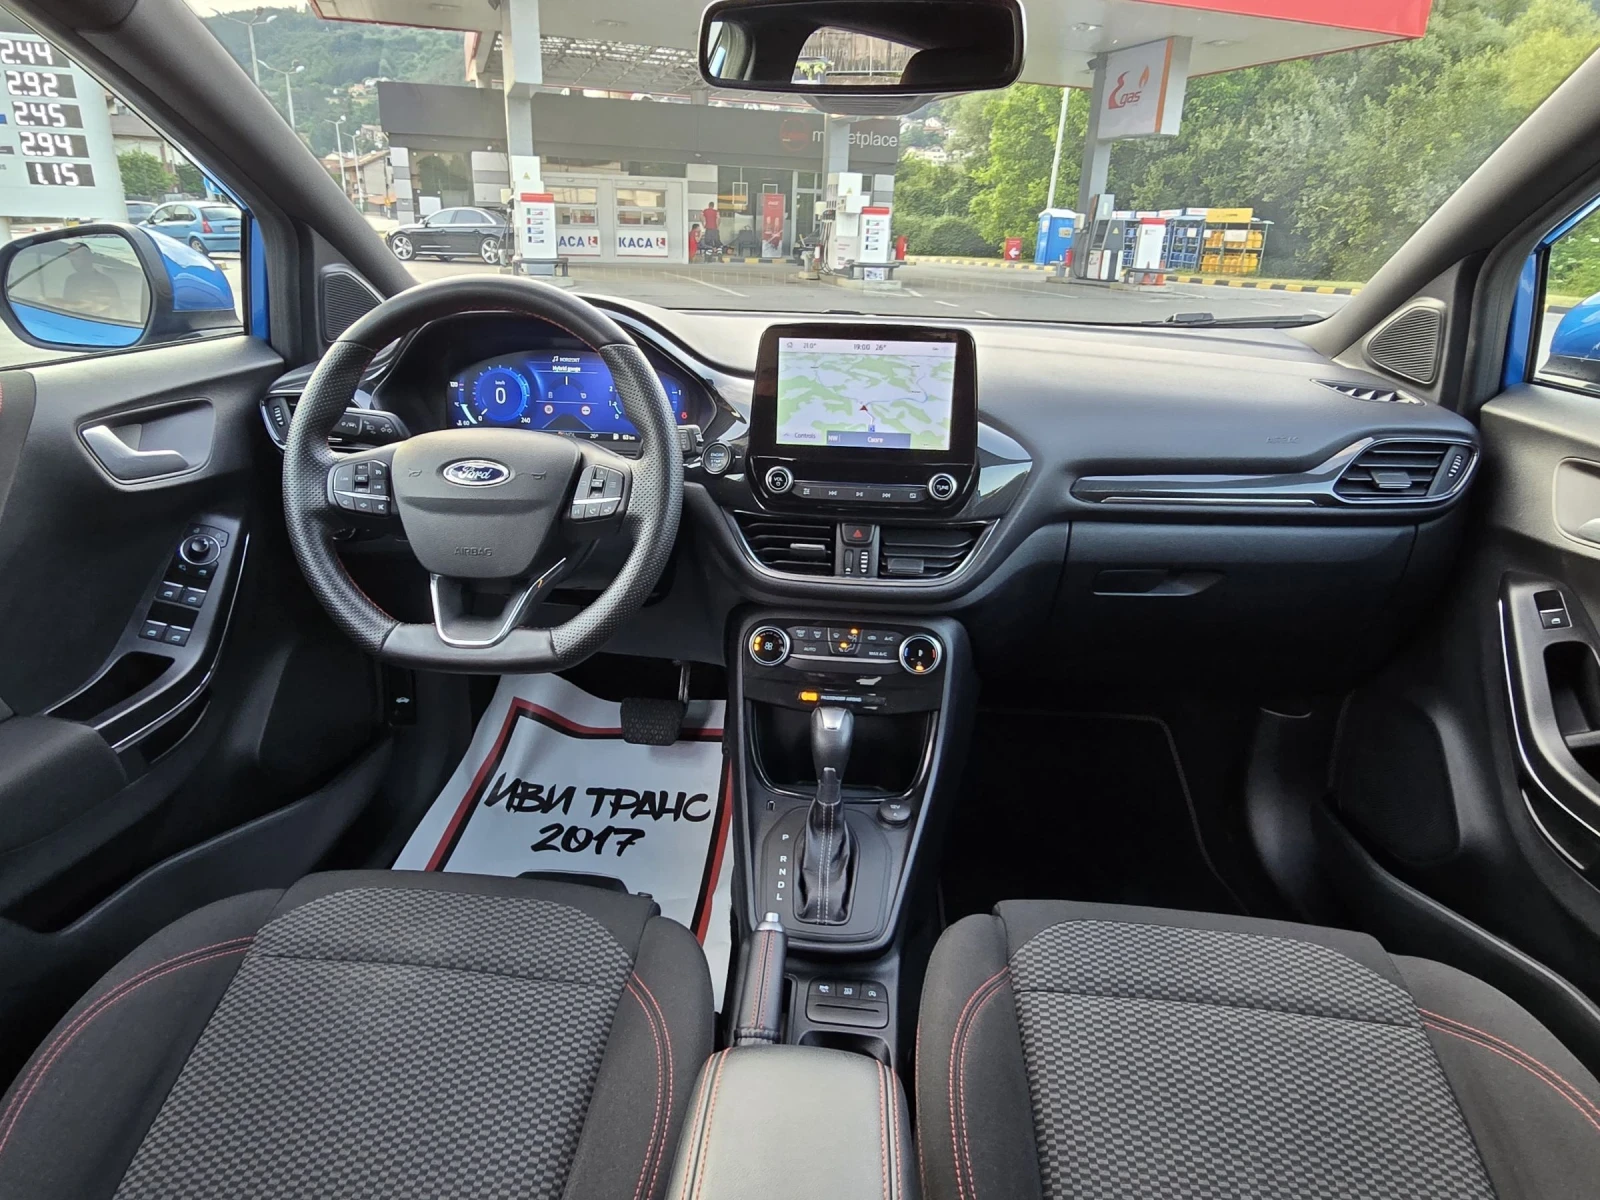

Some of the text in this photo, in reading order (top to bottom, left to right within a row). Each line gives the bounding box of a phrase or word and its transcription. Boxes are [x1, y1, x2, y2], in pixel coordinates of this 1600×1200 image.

[0, 38, 54, 66] 2.44
[6, 70, 59, 97] 2.92
[13, 101, 67, 127] 2.45
[20, 131, 74, 157] 2.94
[812, 129, 898, 149] metplace
[34, 163, 80, 187] 1.15
[557, 235, 585, 248] АСА
[853, 343, 871, 351] 19:00
[495, 387, 506, 405] 0
[794, 431, 816, 439] Controls
[457, 465, 493, 480] Ford
[454, 546, 493, 557] AIRBAG
[484, 771, 711, 822] ИВИ ТРАНС
[530, 822, 646, 857] 2017
[782, 833, 790, 841] P
[780, 855, 788, 863] R
[778, 868, 787, 876] N
[777, 881, 786, 889] D
[776, 892, 783, 901] L
